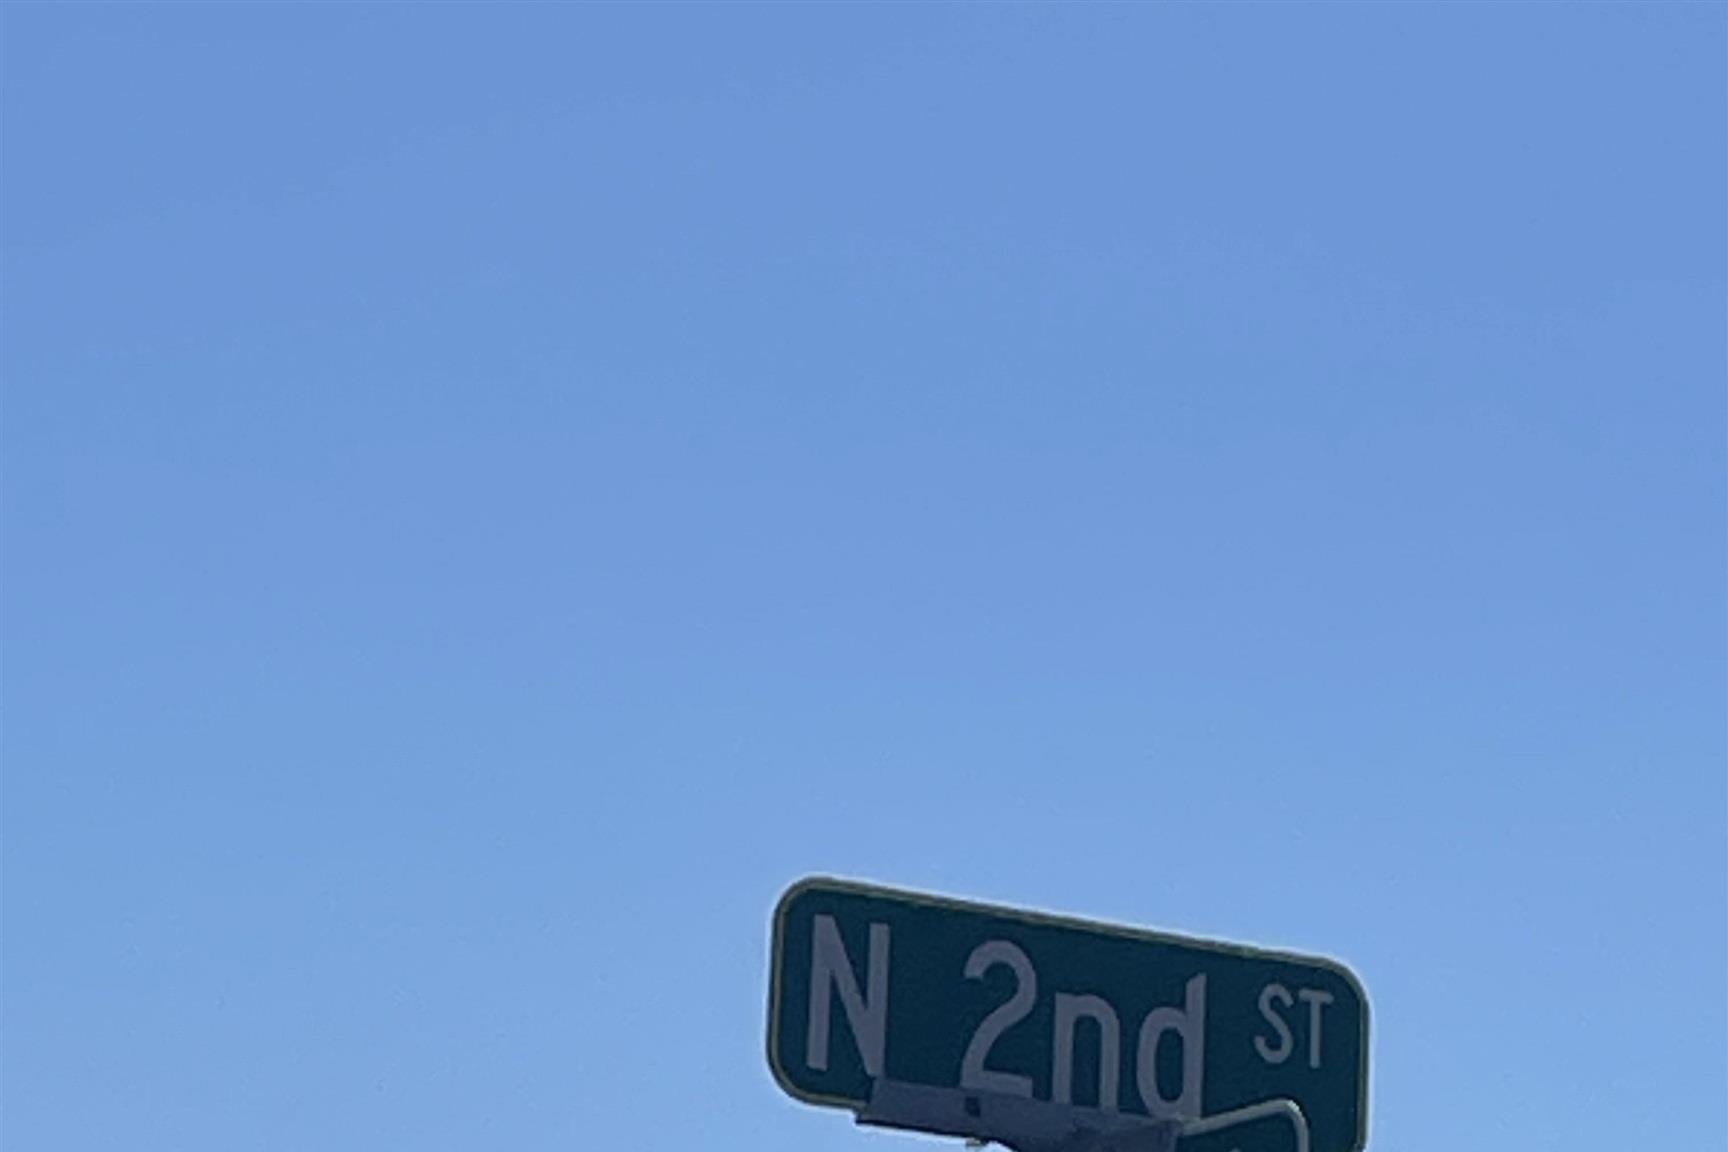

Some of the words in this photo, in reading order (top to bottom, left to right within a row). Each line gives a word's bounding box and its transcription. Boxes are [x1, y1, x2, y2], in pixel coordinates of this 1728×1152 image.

[806, 914, 890, 1077] N
[960, 940, 1206, 1119] 2nd
[1254, 982, 1334, 1069] ST
